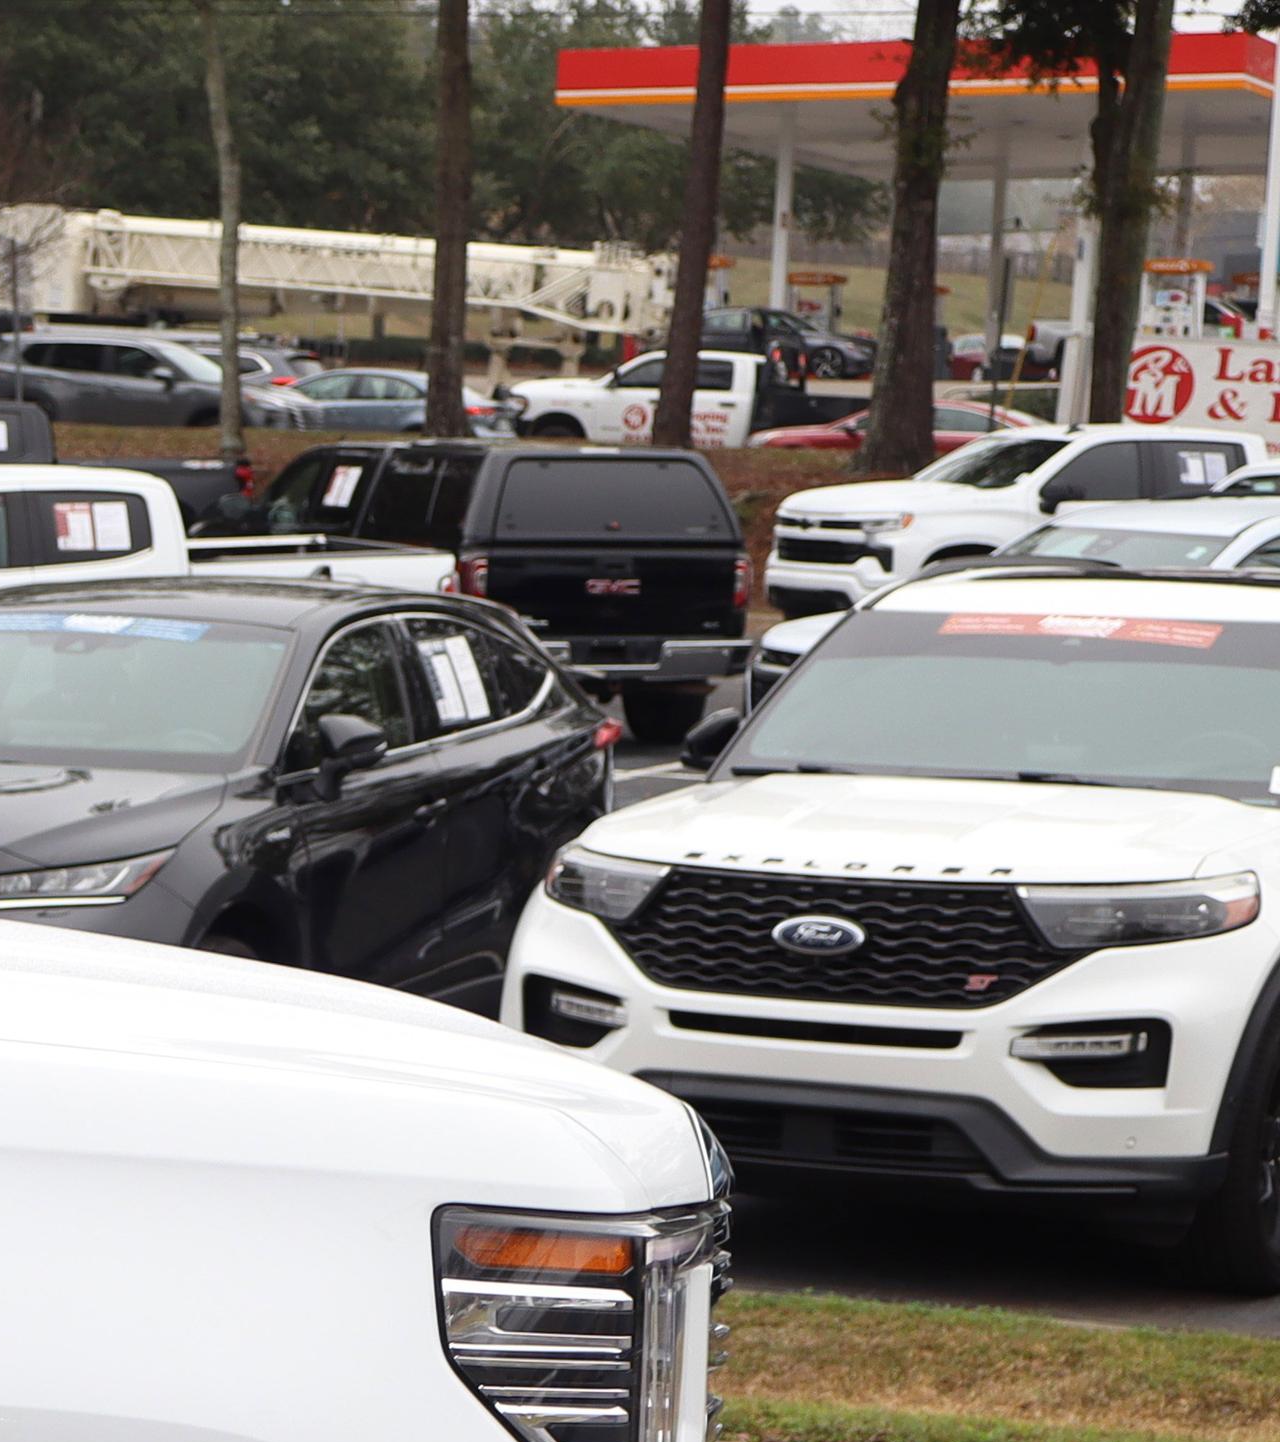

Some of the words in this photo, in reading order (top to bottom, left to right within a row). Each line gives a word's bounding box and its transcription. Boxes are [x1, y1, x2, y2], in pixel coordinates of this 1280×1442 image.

[1215, 347, 1280, 384] La
[1207, 389, 1247, 421] &
[685, 852, 1014, 875] EXPLORER
[964, 974, 999, 991] ST
